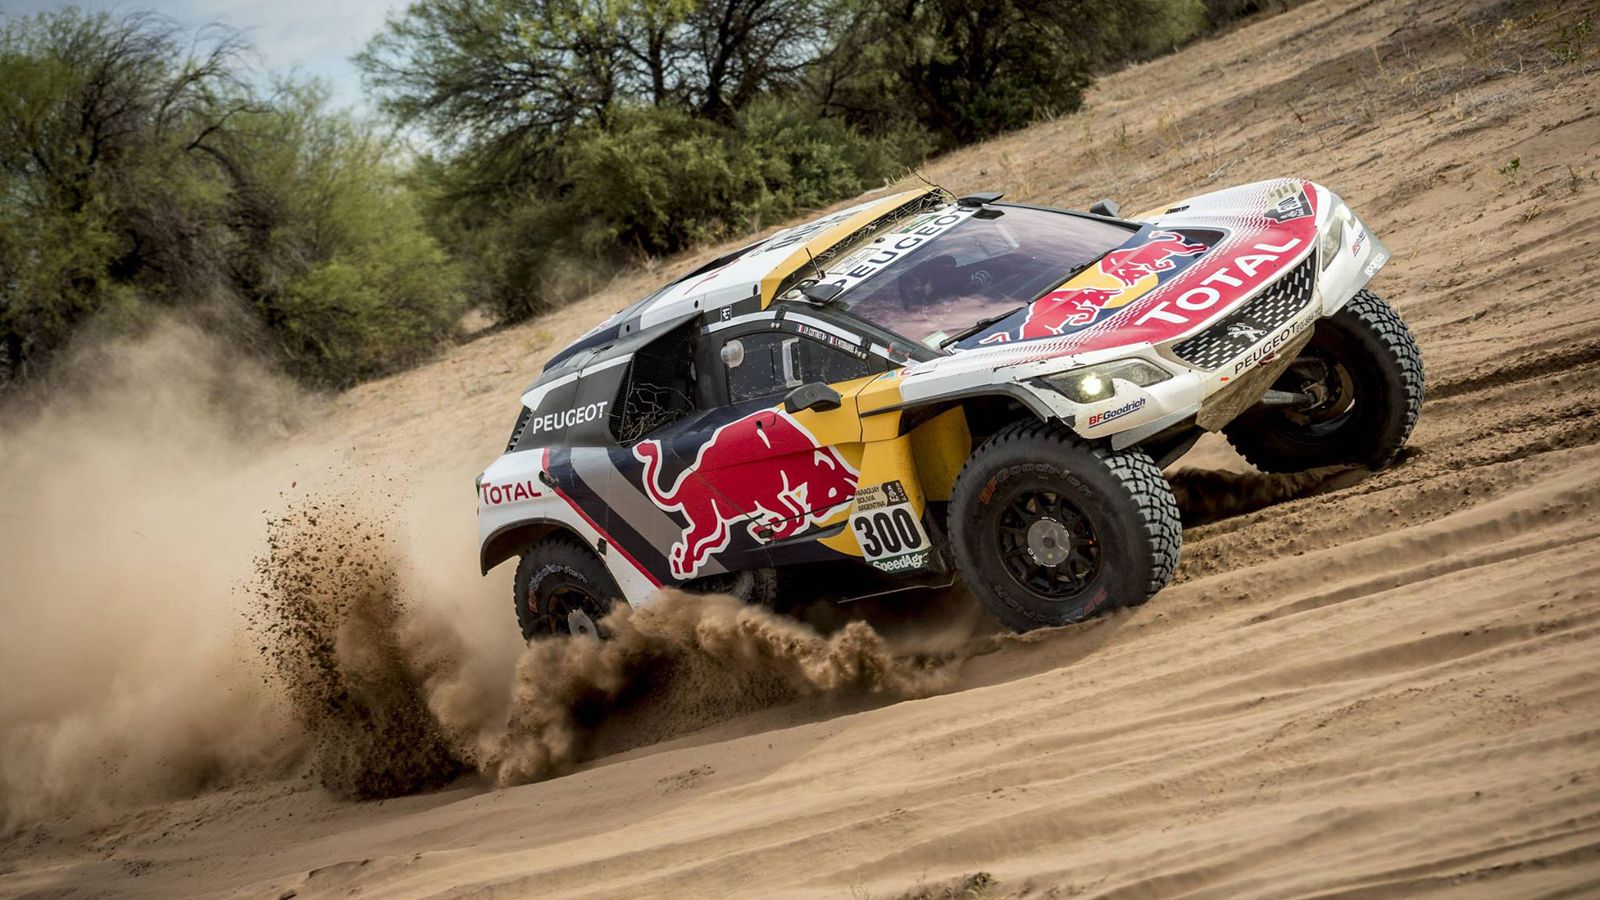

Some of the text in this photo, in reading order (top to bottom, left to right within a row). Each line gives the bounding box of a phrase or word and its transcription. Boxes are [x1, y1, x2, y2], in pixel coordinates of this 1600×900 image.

[1133, 238, 1302, 326] TOTAL
[1234, 321, 1298, 375] PEUGEOT
[532, 401, 608, 434] PEUGEOT
[1088, 397, 1146, 426] BFGoodrich
[481, 481, 542, 505] TOTAL
[858, 500, 886, 512] ARGENTINA
[854, 507, 922, 557] 300
